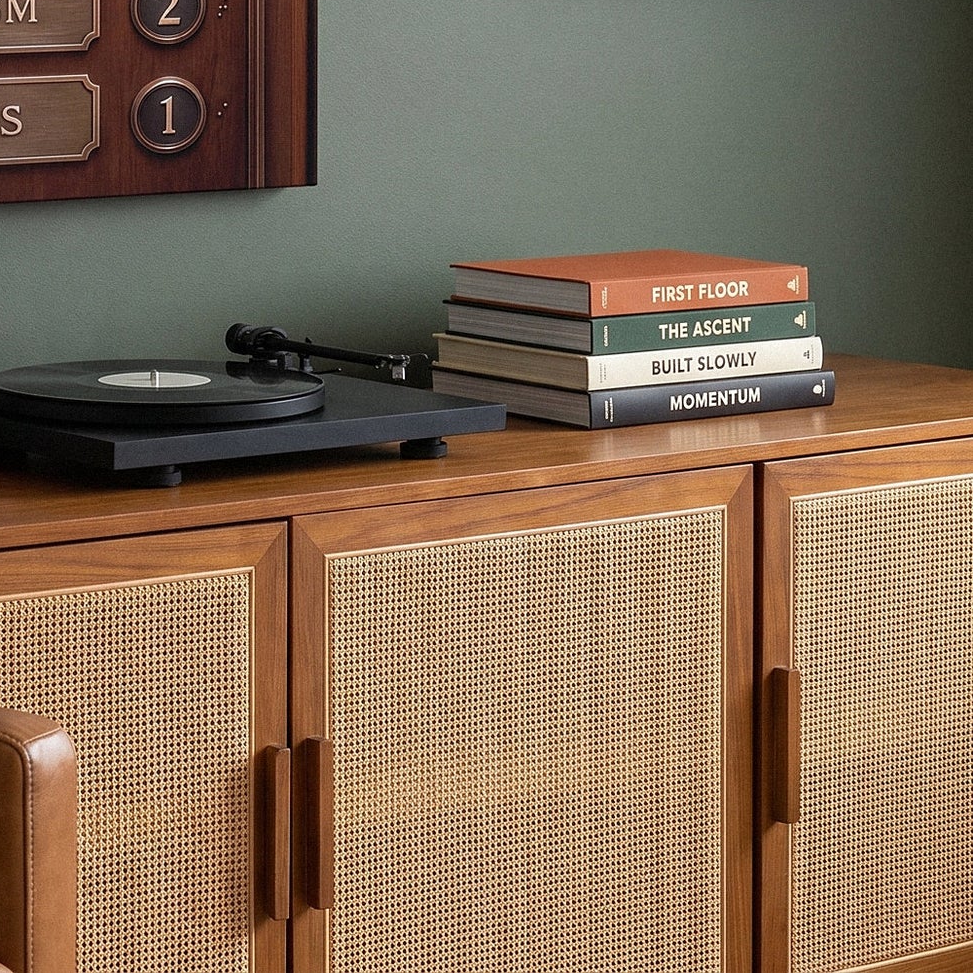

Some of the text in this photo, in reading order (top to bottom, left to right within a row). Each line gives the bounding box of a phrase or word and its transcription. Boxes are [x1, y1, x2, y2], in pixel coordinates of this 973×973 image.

[160, 95, 176, 134] 1
[651, 281, 749, 303] FIRST FLOOR
[659, 317, 752, 340] THE ASCENT
[651, 351, 757, 376] BUILT SLOWLY
[670, 388, 761, 411] MOMENTUM
